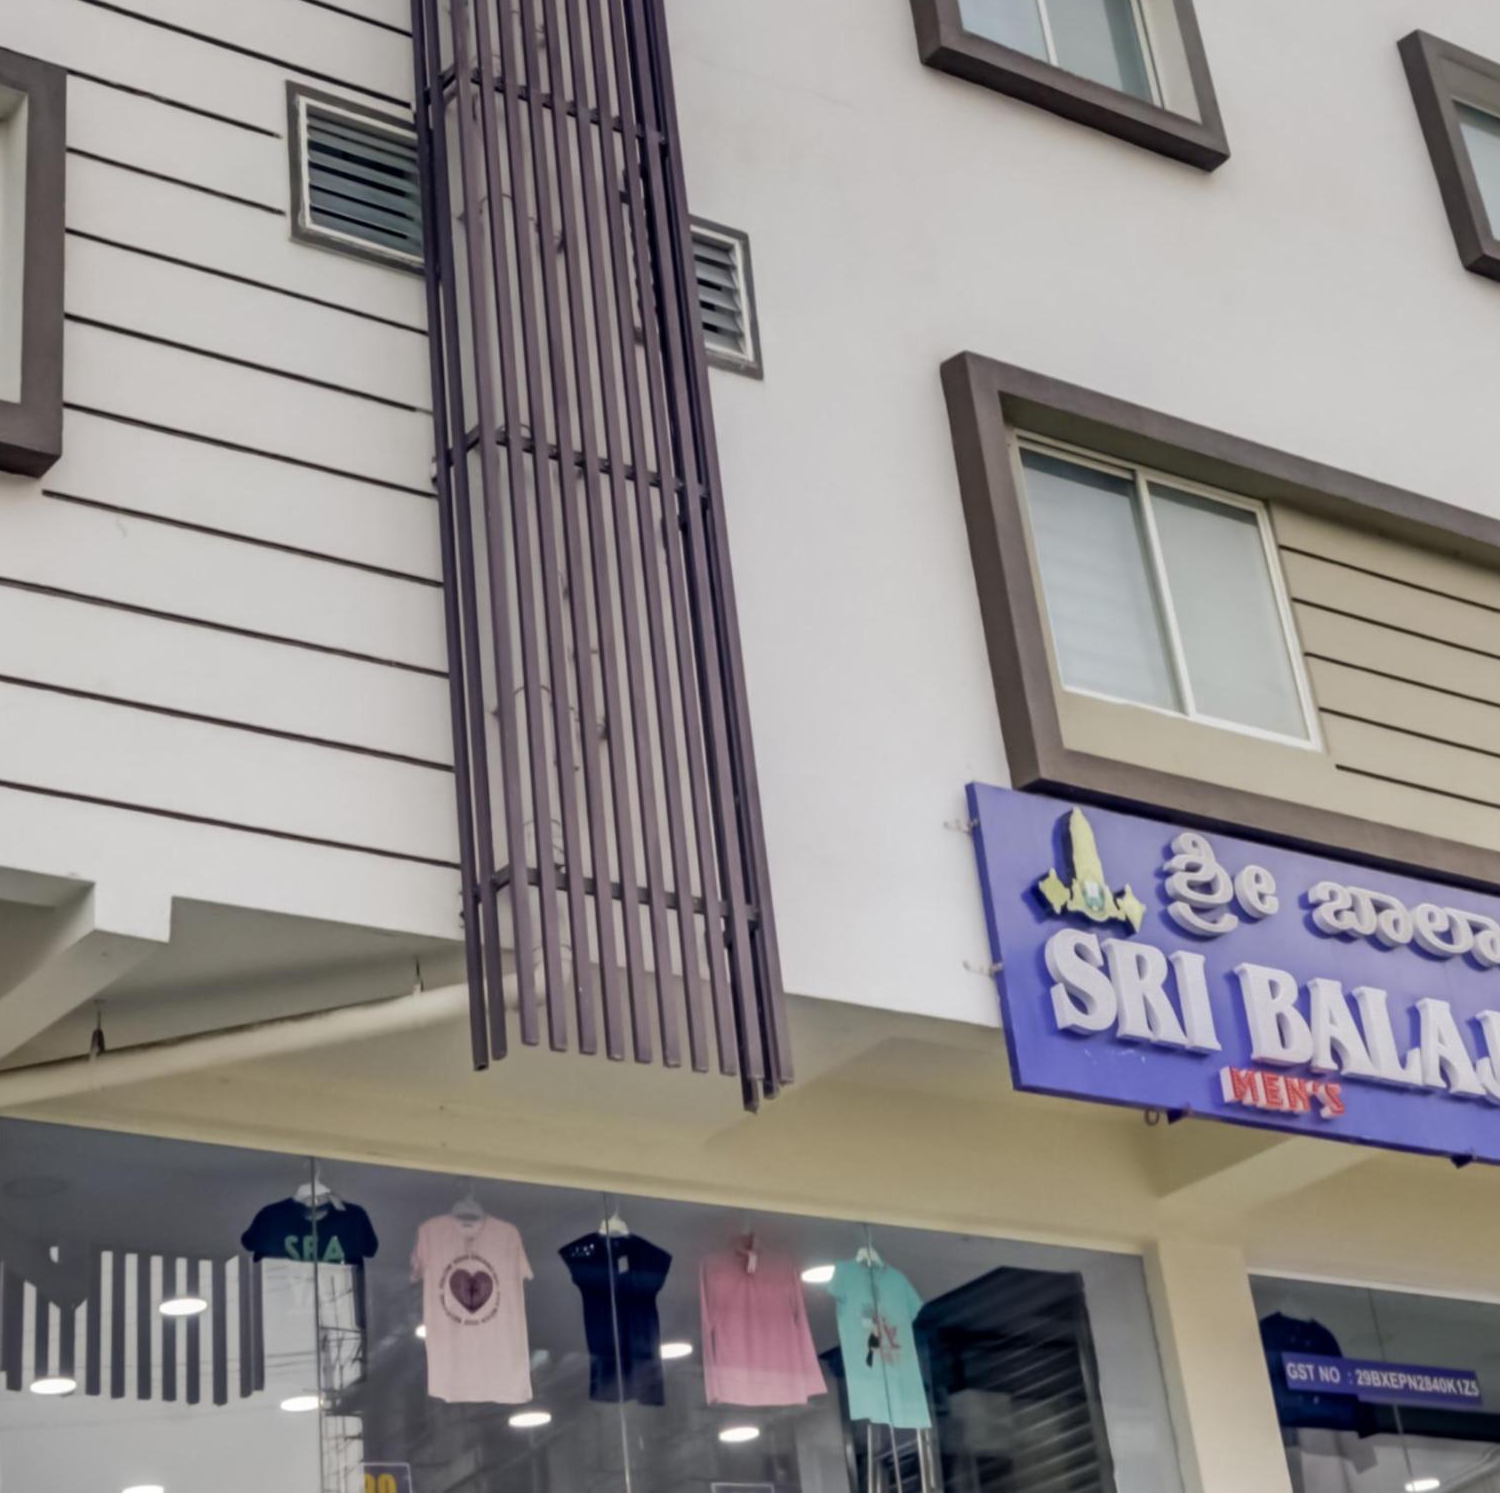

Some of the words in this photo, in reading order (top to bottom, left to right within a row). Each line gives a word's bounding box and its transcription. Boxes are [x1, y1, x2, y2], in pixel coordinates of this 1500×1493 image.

[1164, 832, 1279, 937] ಶ್ರೀ
[1044, 928, 1222, 1054] SRI
[1220, 1066, 1346, 1119] MEN'S
[1286, 1362, 1315, 1381] GST
[1318, 1366, 1341, 1385] NO
